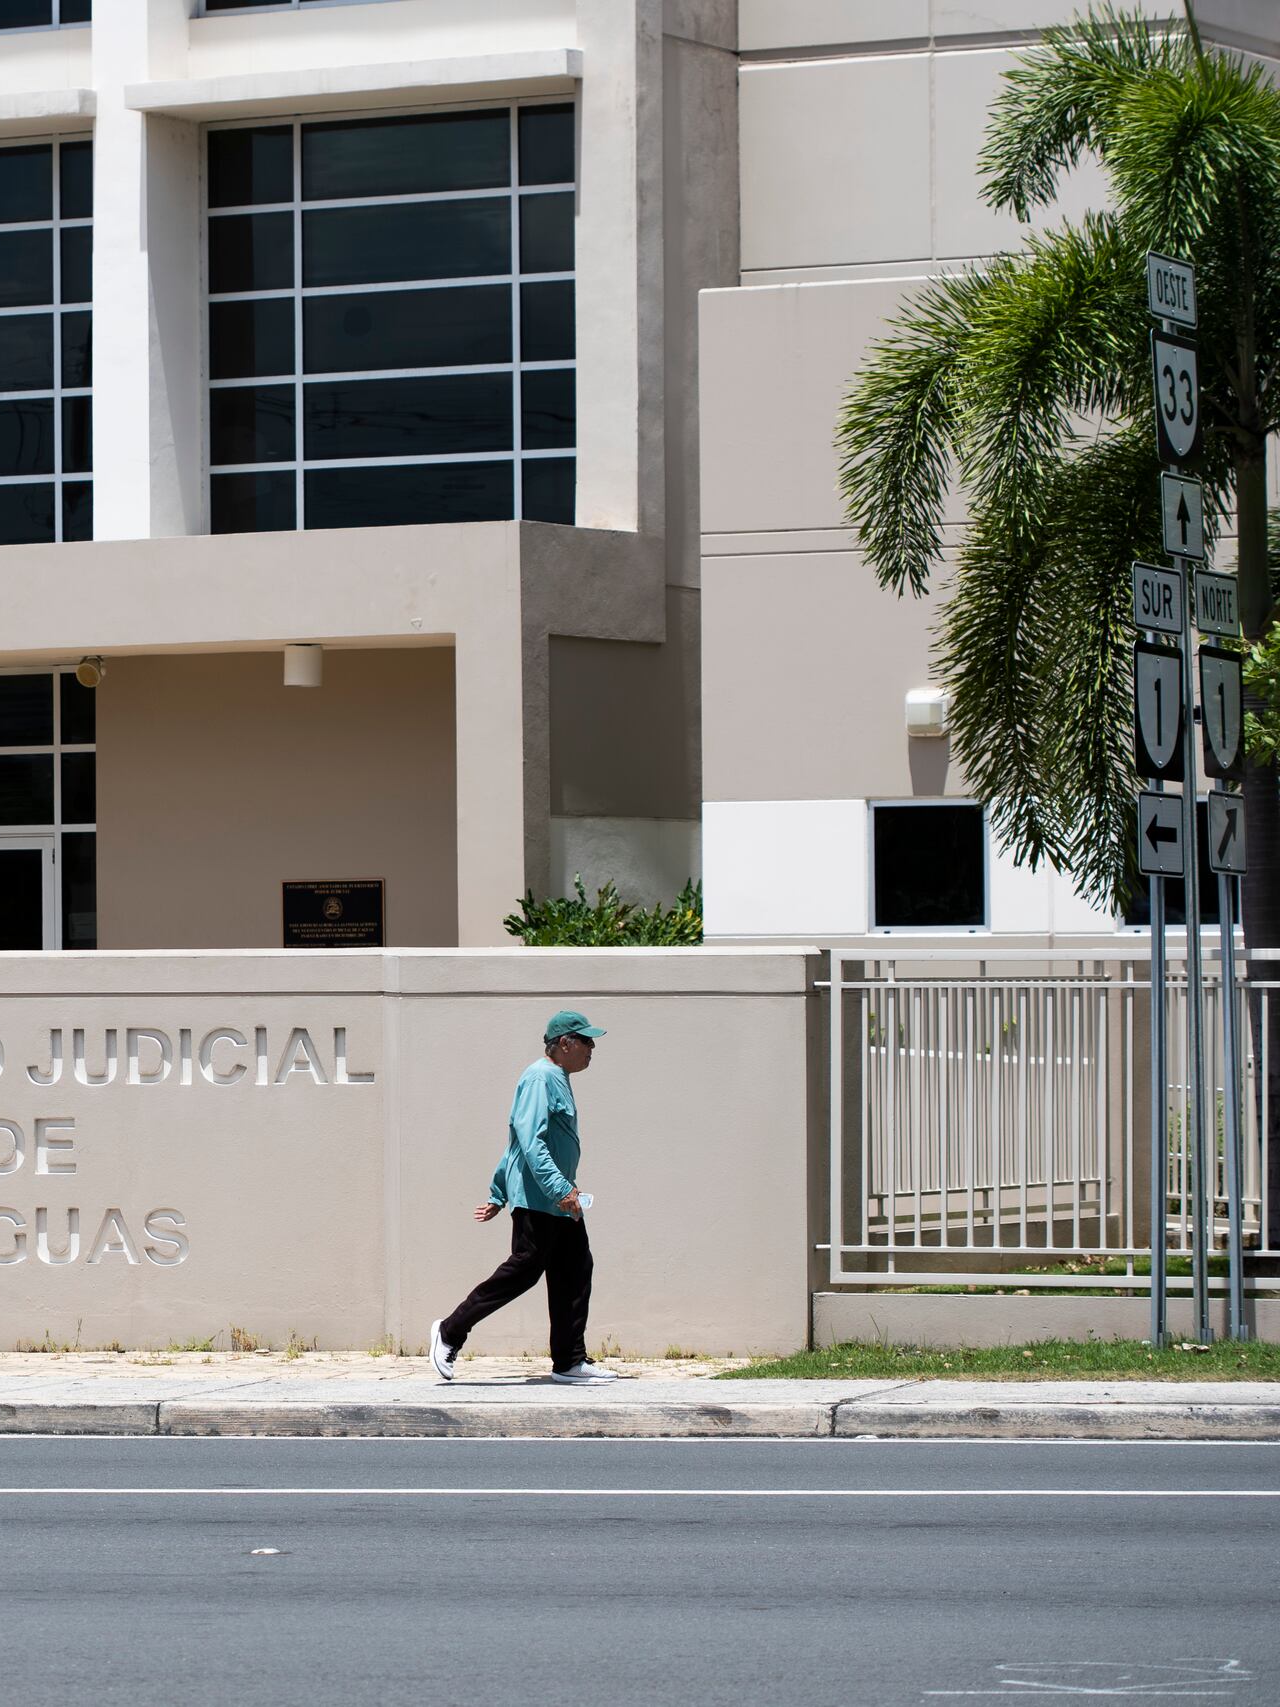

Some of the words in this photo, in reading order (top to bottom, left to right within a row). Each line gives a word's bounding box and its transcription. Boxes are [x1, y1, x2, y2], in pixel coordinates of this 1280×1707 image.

[1156, 268, 1189, 311] OESTE
[1163, 364, 1194, 426] 33
[1142, 578, 1173, 620] SUR
[1202, 585, 1234, 624] NORTE
[1154, 678, 1162, 747] 1
[1218, 682, 1226, 749] 1
[25, 1025, 375, 1086] JUDICIAL
